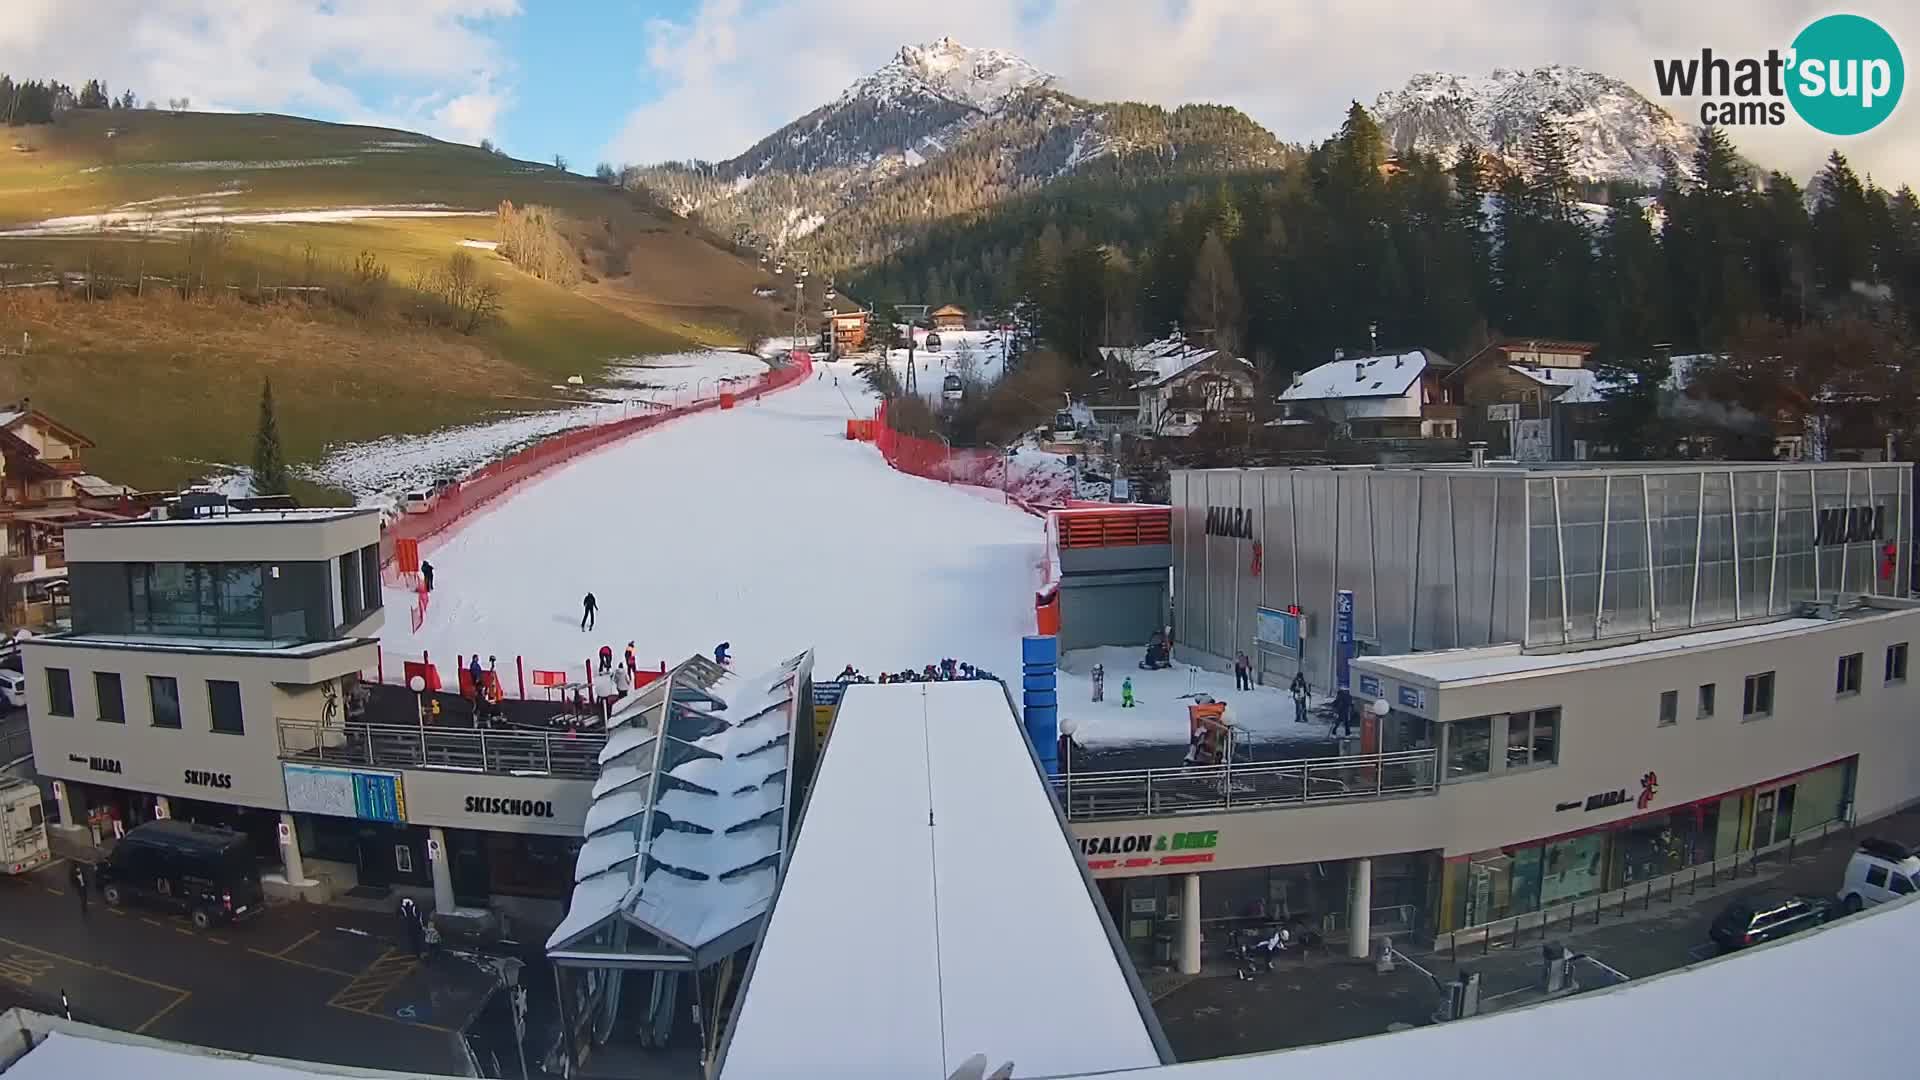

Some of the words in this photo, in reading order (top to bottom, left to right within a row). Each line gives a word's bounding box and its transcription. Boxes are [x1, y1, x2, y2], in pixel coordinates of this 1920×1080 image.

[1205, 505, 1253, 540] MIARA
[1815, 505, 1885, 546] MIARA
[184, 769, 232, 789] SKIPASS
[465, 795, 555, 818] SKISCHOOL
[1076, 834, 1153, 855] ISALON
[1155, 835, 1167, 851] &
